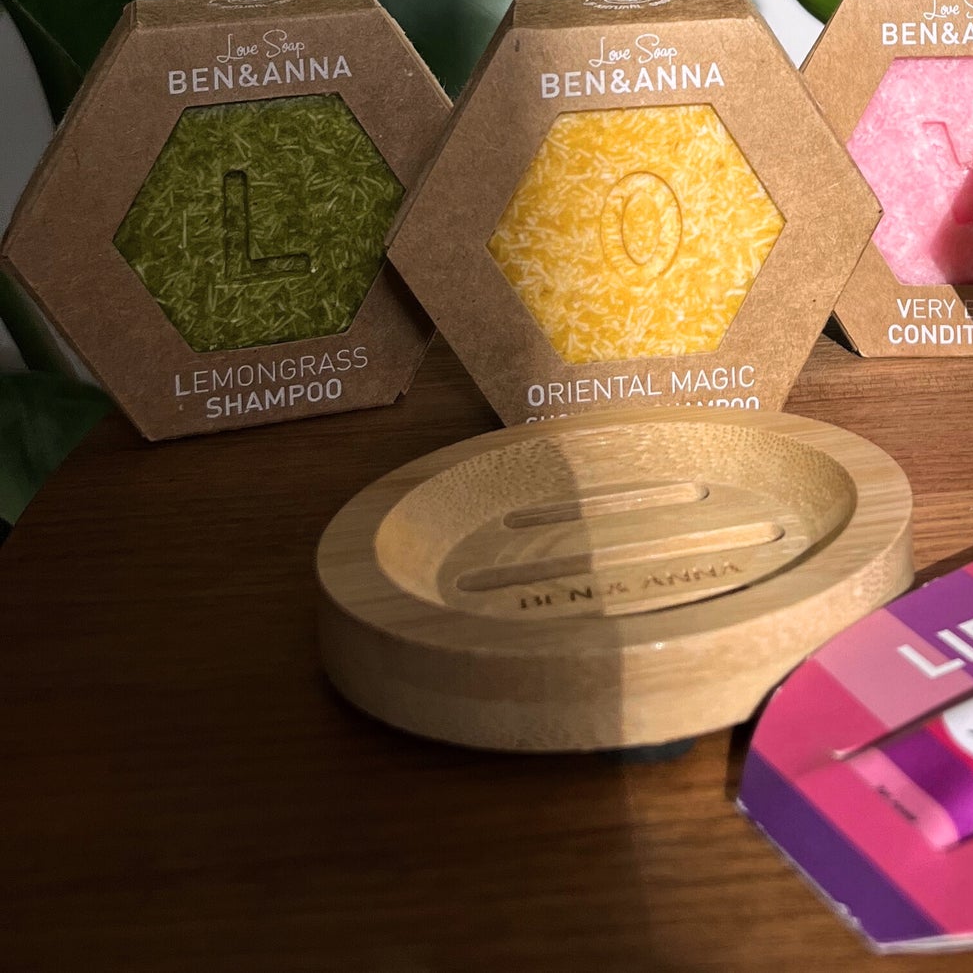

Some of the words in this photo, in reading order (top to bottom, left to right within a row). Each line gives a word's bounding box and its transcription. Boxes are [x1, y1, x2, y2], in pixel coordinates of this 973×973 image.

[216, 33, 260, 63] Love
[263, 29, 306, 59] Soap
[588, 36, 632, 67] Love
[635, 33, 678, 64] Soap
[168, 55, 353, 95] BEN&ANNA
[540, 63, 725, 99] BEN&ANNA
[896, 298, 956, 319] VERY
[175, 346, 369, 397] LEMONGRASS
[526, 374, 662, 407] ORIENTAL
[670, 365, 756, 393] MAGIC
[206, 378, 342, 419] SHAMPOO
